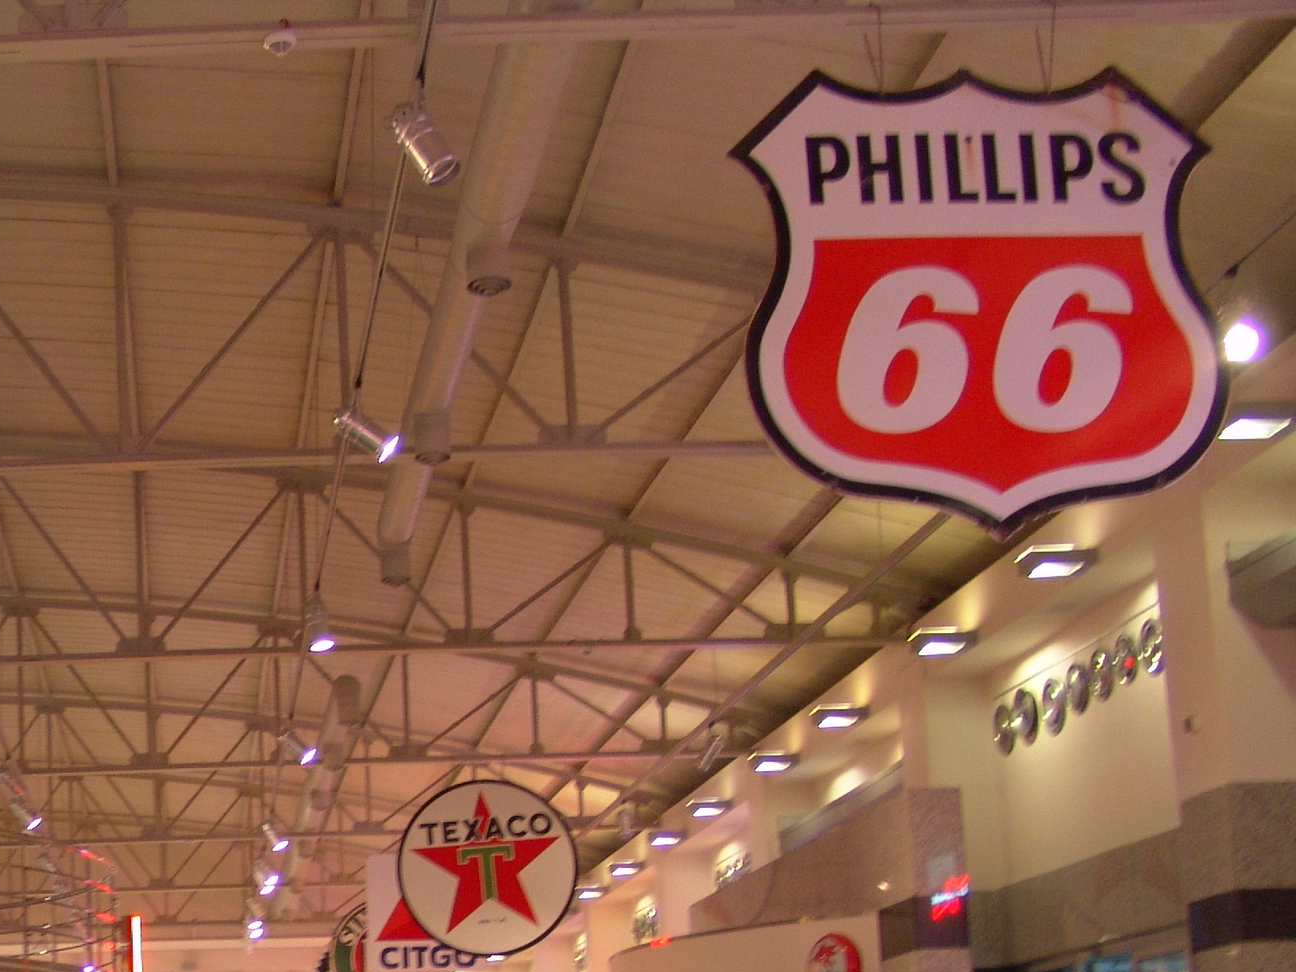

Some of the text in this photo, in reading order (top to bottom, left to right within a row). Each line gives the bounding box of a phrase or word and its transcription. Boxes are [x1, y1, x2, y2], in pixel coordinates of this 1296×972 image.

[805, 132, 1147, 205] PHILLIPS
[836, 264, 1133, 435] 66
[419, 813, 552, 846] TEXACO
[380, 946, 477, 969] CITGO
